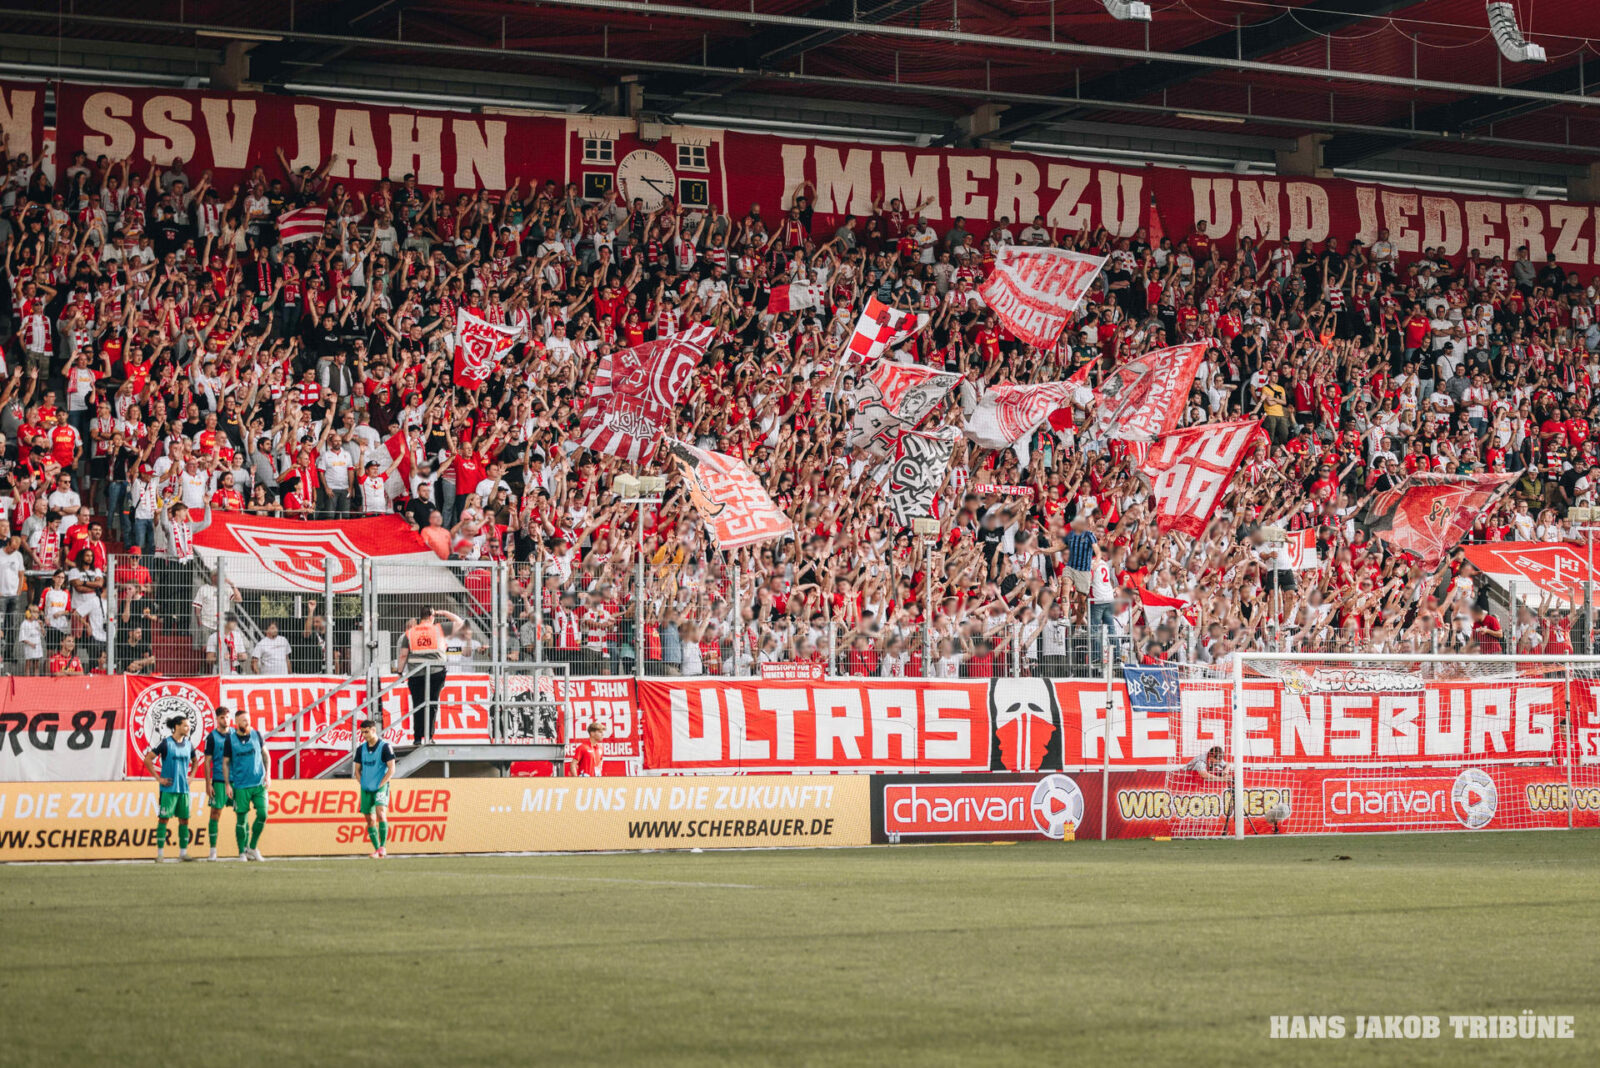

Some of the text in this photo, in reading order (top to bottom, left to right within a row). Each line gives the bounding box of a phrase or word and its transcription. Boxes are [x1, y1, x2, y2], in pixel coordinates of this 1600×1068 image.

[82, 92, 507, 191] SSV JAHN
[691, 183, 703, 202] 0
[780, 144, 1144, 238] IMMERZU
[1191, 177, 1600, 265] UND JEDERZ
[1100, 567, 1109, 583] 2
[558, 681, 586, 697] SSV
[591, 681, 629, 697] JAHN
[1127, 678, 1142, 696] BB
[67, 710, 117, 751] 81
[561, 701, 632, 739] 1889
[669, 687, 971, 762] ULTRAS
[1078, 687, 1554, 759] REGENSBURG
[564, 742, 633, 756] REBURG
[14, 792, 62, 819] DIE
[67, 791, 207, 819] ZUKUNT!
[267, 789, 451, 815] SCHERUER
[521, 788, 569, 812] MIT
[575, 787, 627, 811] UNS
[634, 787, 662, 811] IN
[669, 786, 710, 811] DIE
[714, 785, 834, 810] ZUKUNFT!
[893, 786, 1025, 823] charivari
[1118, 790, 1172, 819] WIR
[1173, 795, 1220, 817] von
[1330, 780, 1446, 816] charivari
[1527, 784, 1573, 811] WIR
[628, 818, 834, 838] WWW.SCHERBAUER.DE
